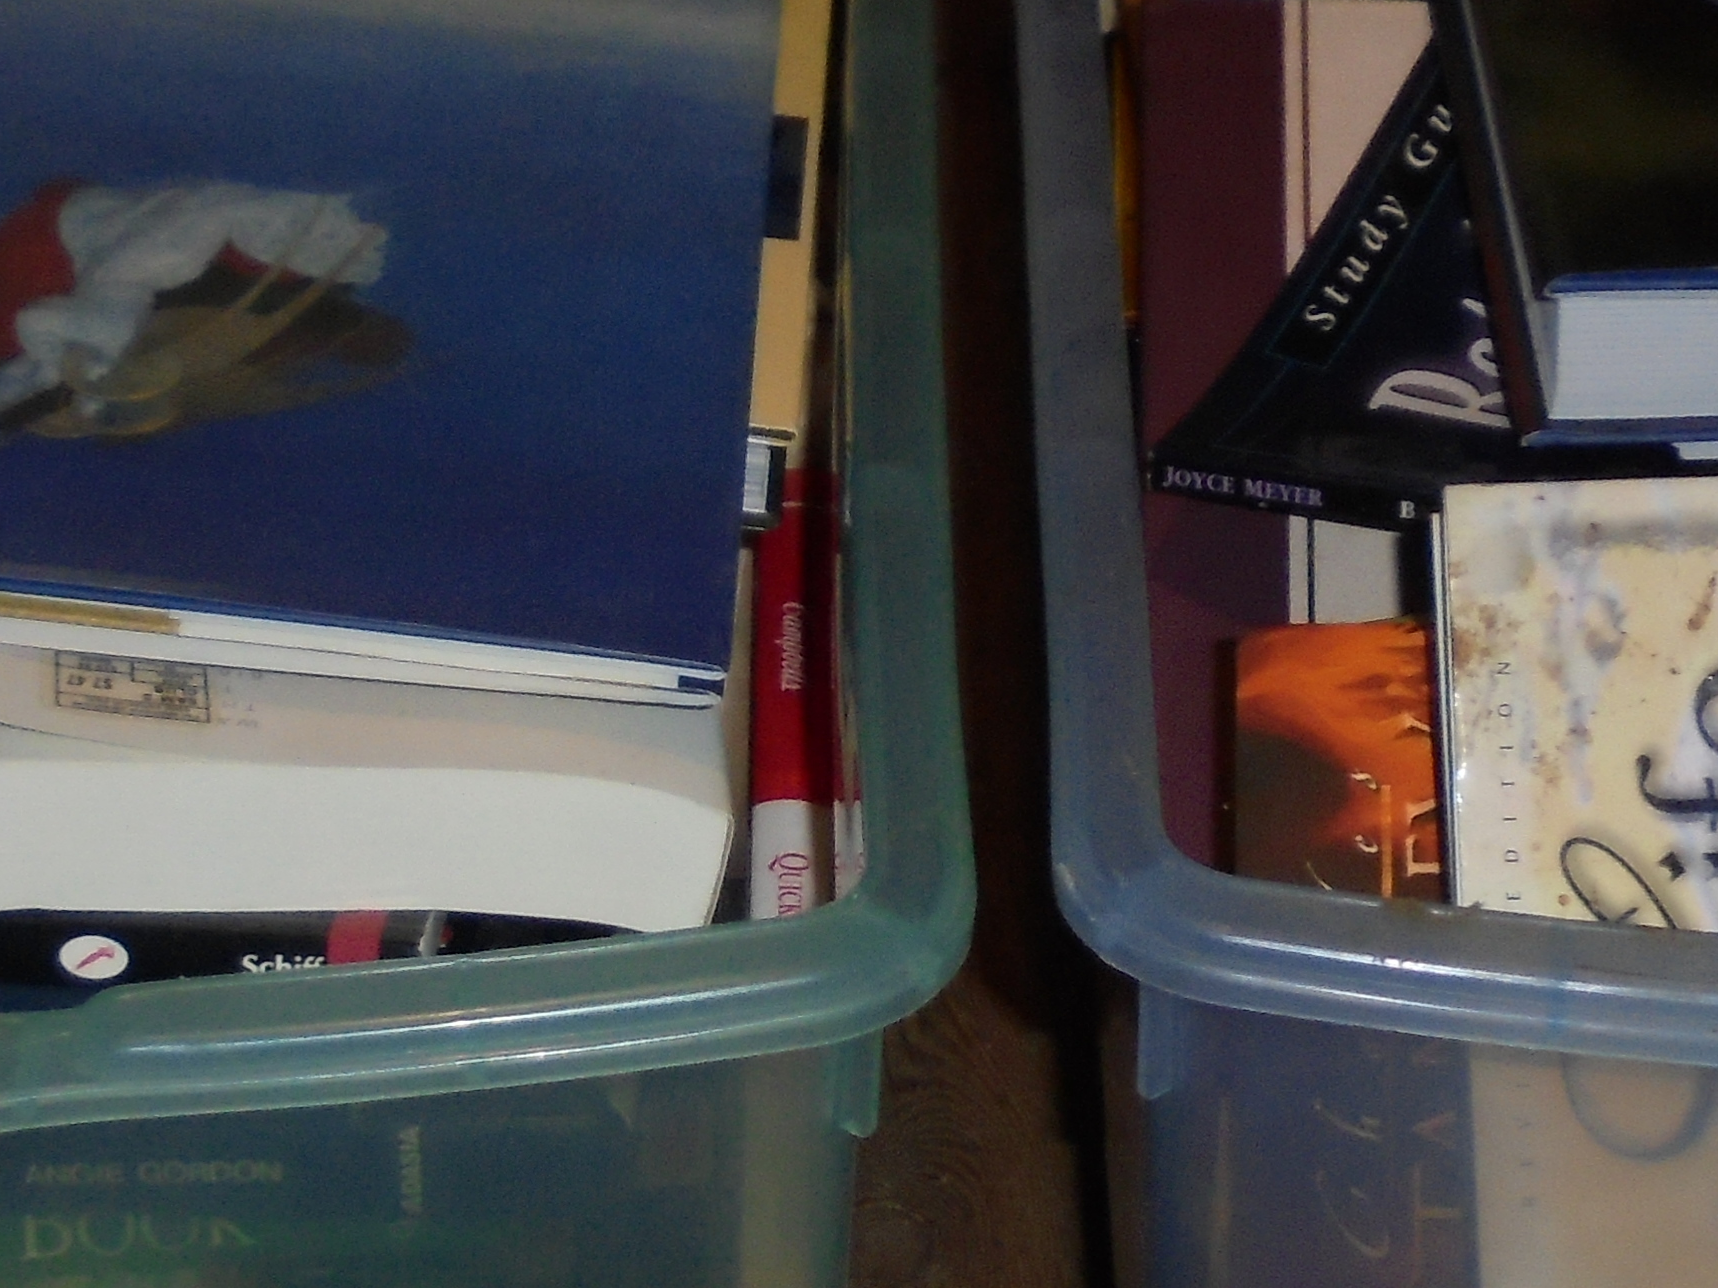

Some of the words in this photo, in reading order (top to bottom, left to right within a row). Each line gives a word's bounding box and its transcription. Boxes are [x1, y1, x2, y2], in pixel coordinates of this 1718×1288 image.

[1303, 192, 1409, 334] Study
[1162, 464, 1237, 496] JOYCE
[1243, 476, 1325, 510] MEYER
[1495, 658, 1522, 901] EDITION
[768, 851, 811, 918] QUICK
[137, 1158, 286, 1185] GORDON
